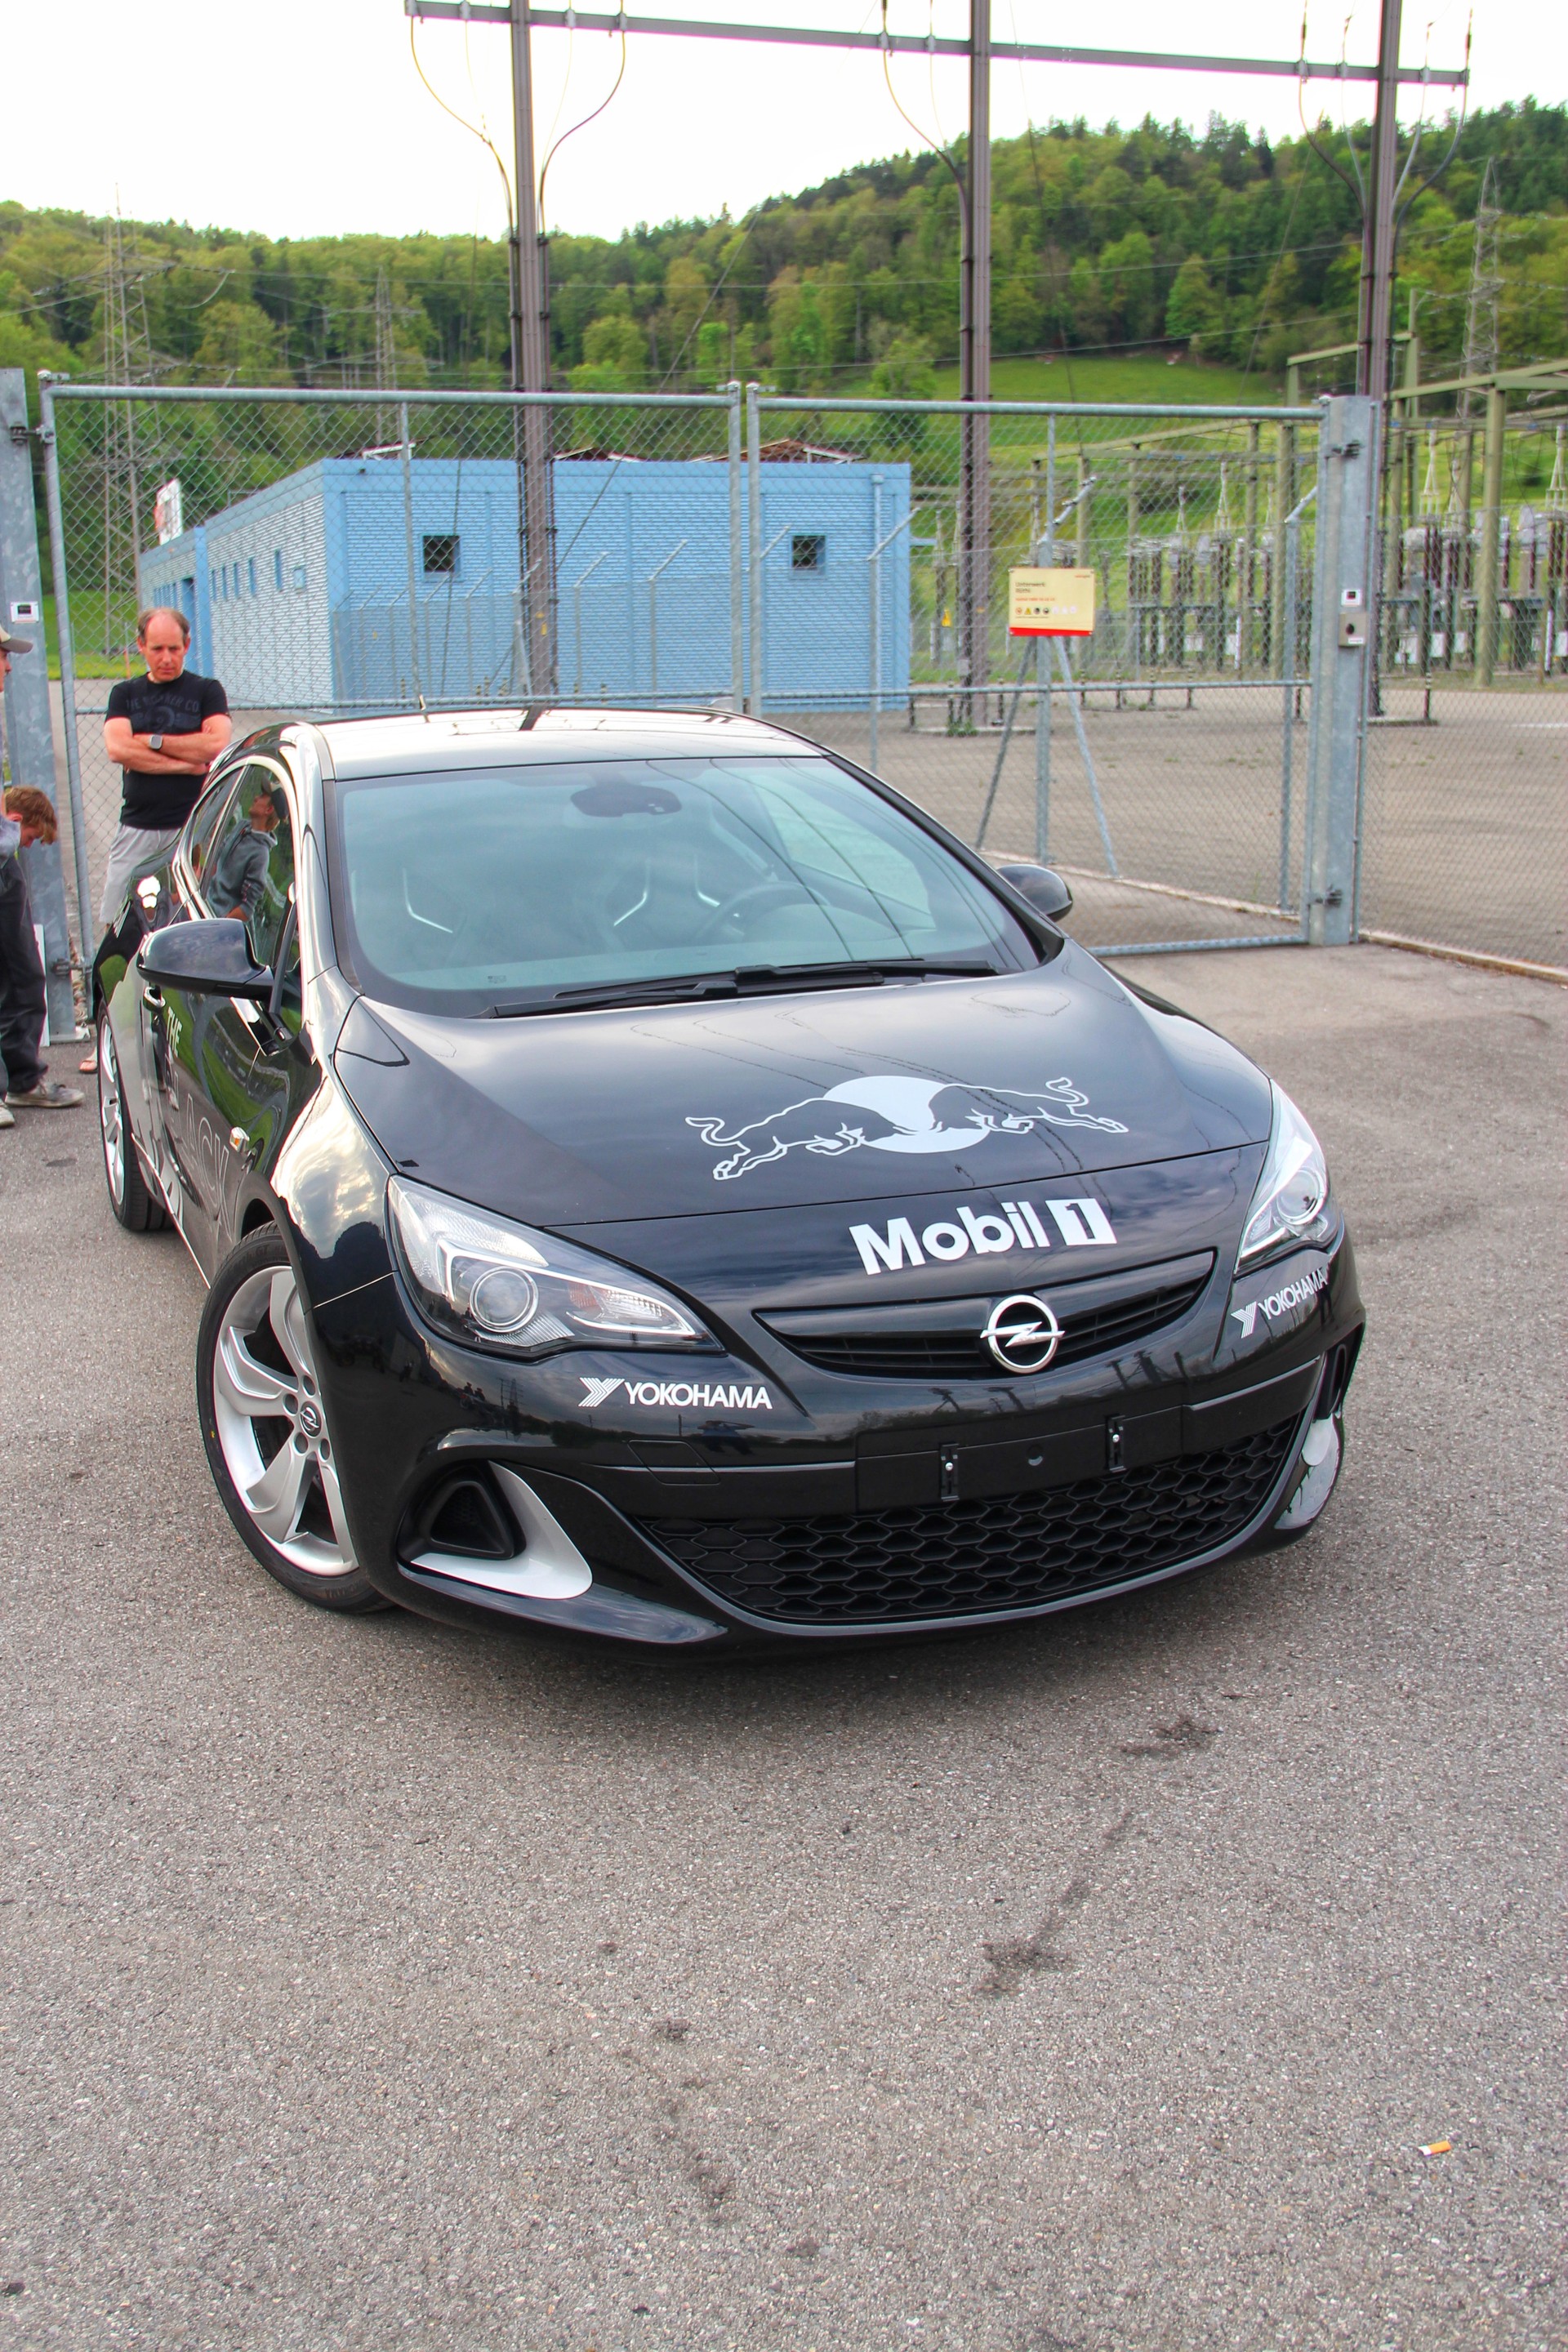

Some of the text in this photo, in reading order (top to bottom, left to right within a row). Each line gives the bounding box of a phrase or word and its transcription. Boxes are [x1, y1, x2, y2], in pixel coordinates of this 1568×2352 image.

[167, 1006, 182, 1058] THE
[849, 1200, 1050, 1276] Mobil
[1258, 1268, 1328, 1321] YOKOHAMA
[624, 1381, 773, 1410] YOKOHAMA
